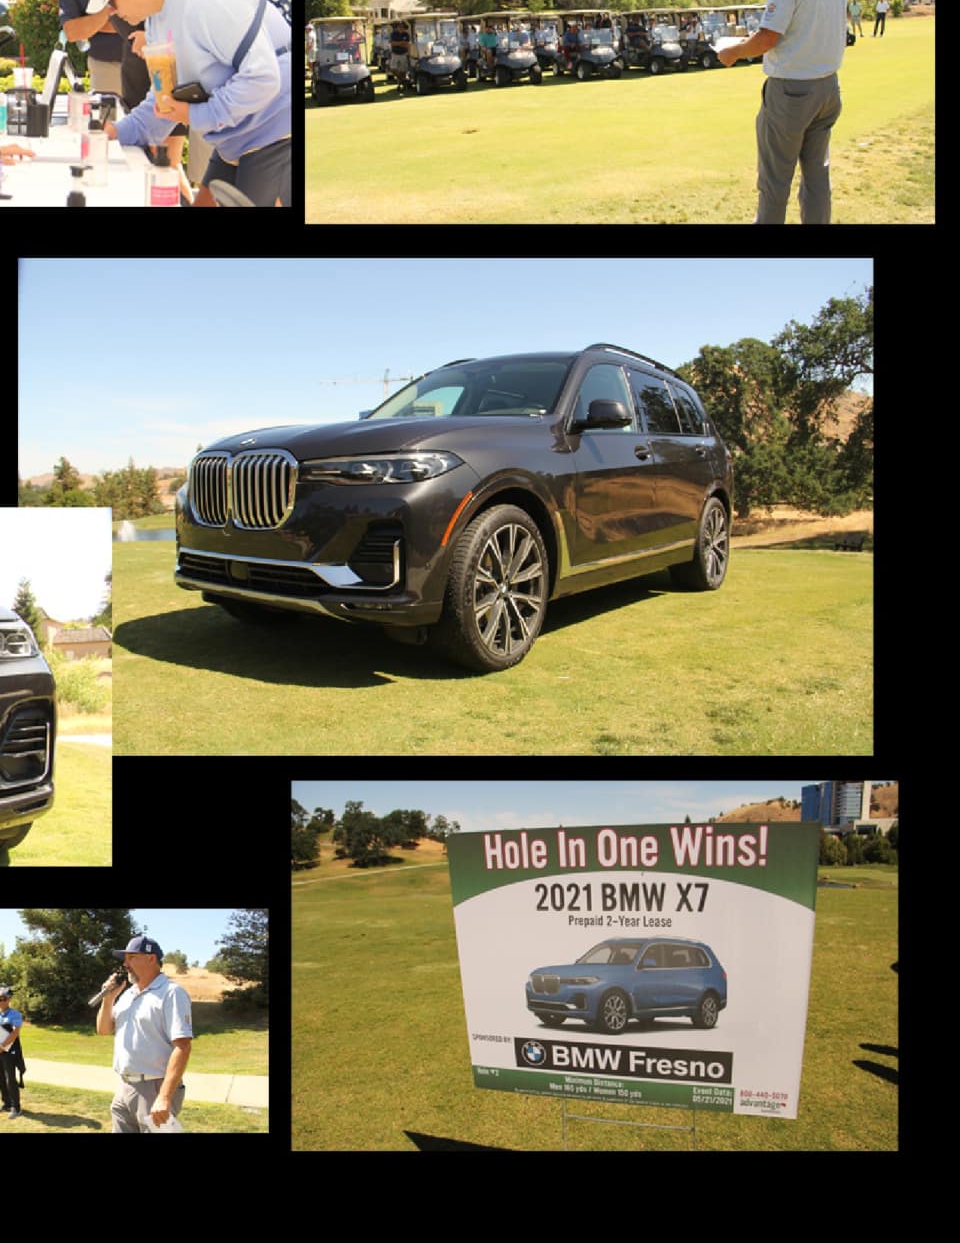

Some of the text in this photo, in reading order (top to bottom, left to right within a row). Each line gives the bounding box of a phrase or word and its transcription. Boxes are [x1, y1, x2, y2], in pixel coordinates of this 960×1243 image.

[483, 824, 769, 870] Hole In One Wins!
[535, 882, 710, 912] 2021 BMW X7
[568, 915, 672, 928] Prepaid 2-Year Lease
[551, 1044, 725, 1079] BMW Fresno
